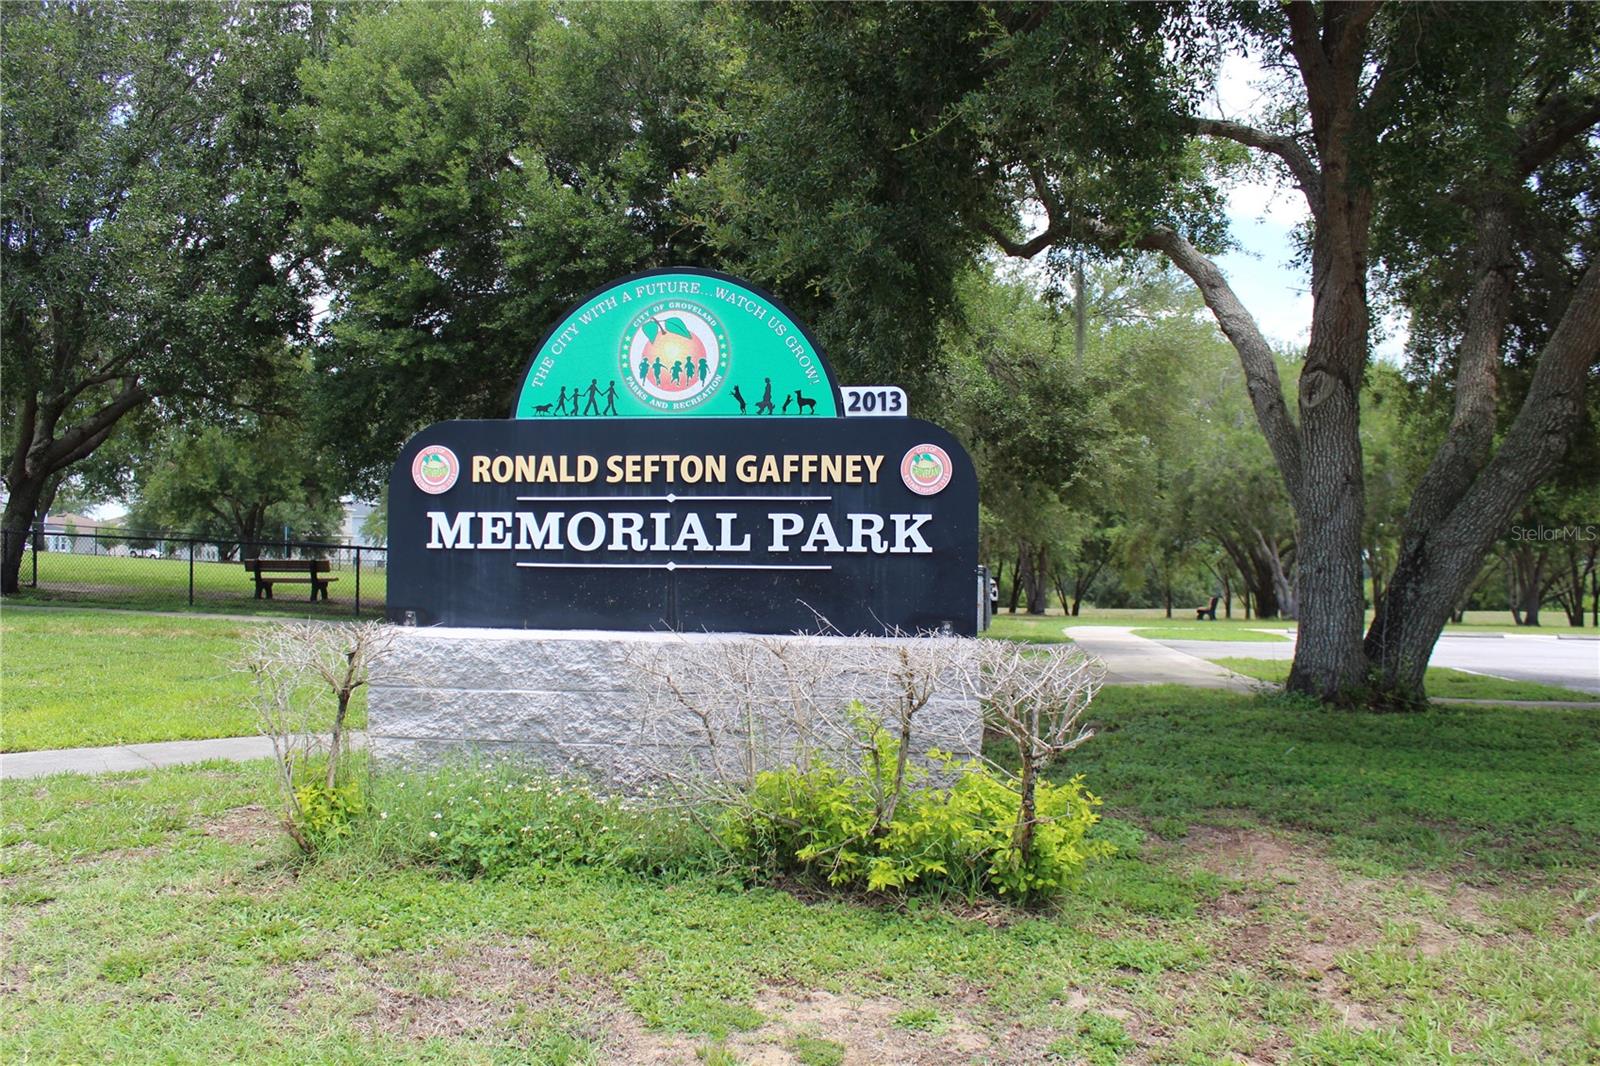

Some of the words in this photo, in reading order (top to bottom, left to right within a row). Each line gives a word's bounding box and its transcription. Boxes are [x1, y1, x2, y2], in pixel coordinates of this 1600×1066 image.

[633, 311, 650, 328] CITY
[653, 304, 665, 312] OF
[669, 302, 717, 327] GROVELAND
[531, 357, 554, 388] THE
[551, 323, 579, 355] CITY
[578, 296, 618, 325] WITH
[622, 291, 632, 303] A
[767, 316, 787, 336] US
[785, 335, 820, 385] GROW!
[626, 376, 648, 401] PARKS
[649, 399, 668, 409] AND
[673, 374, 723, 409] RECREATION
[848, 391, 902, 412] 2013
[472, 455, 599, 483] RONALD
[606, 455, 726, 484] SEFTON
[736, 454, 885, 483] GAFFNEY
[426, 511, 751, 551] MEMORIAL
[767, 513, 933, 553] PARK
